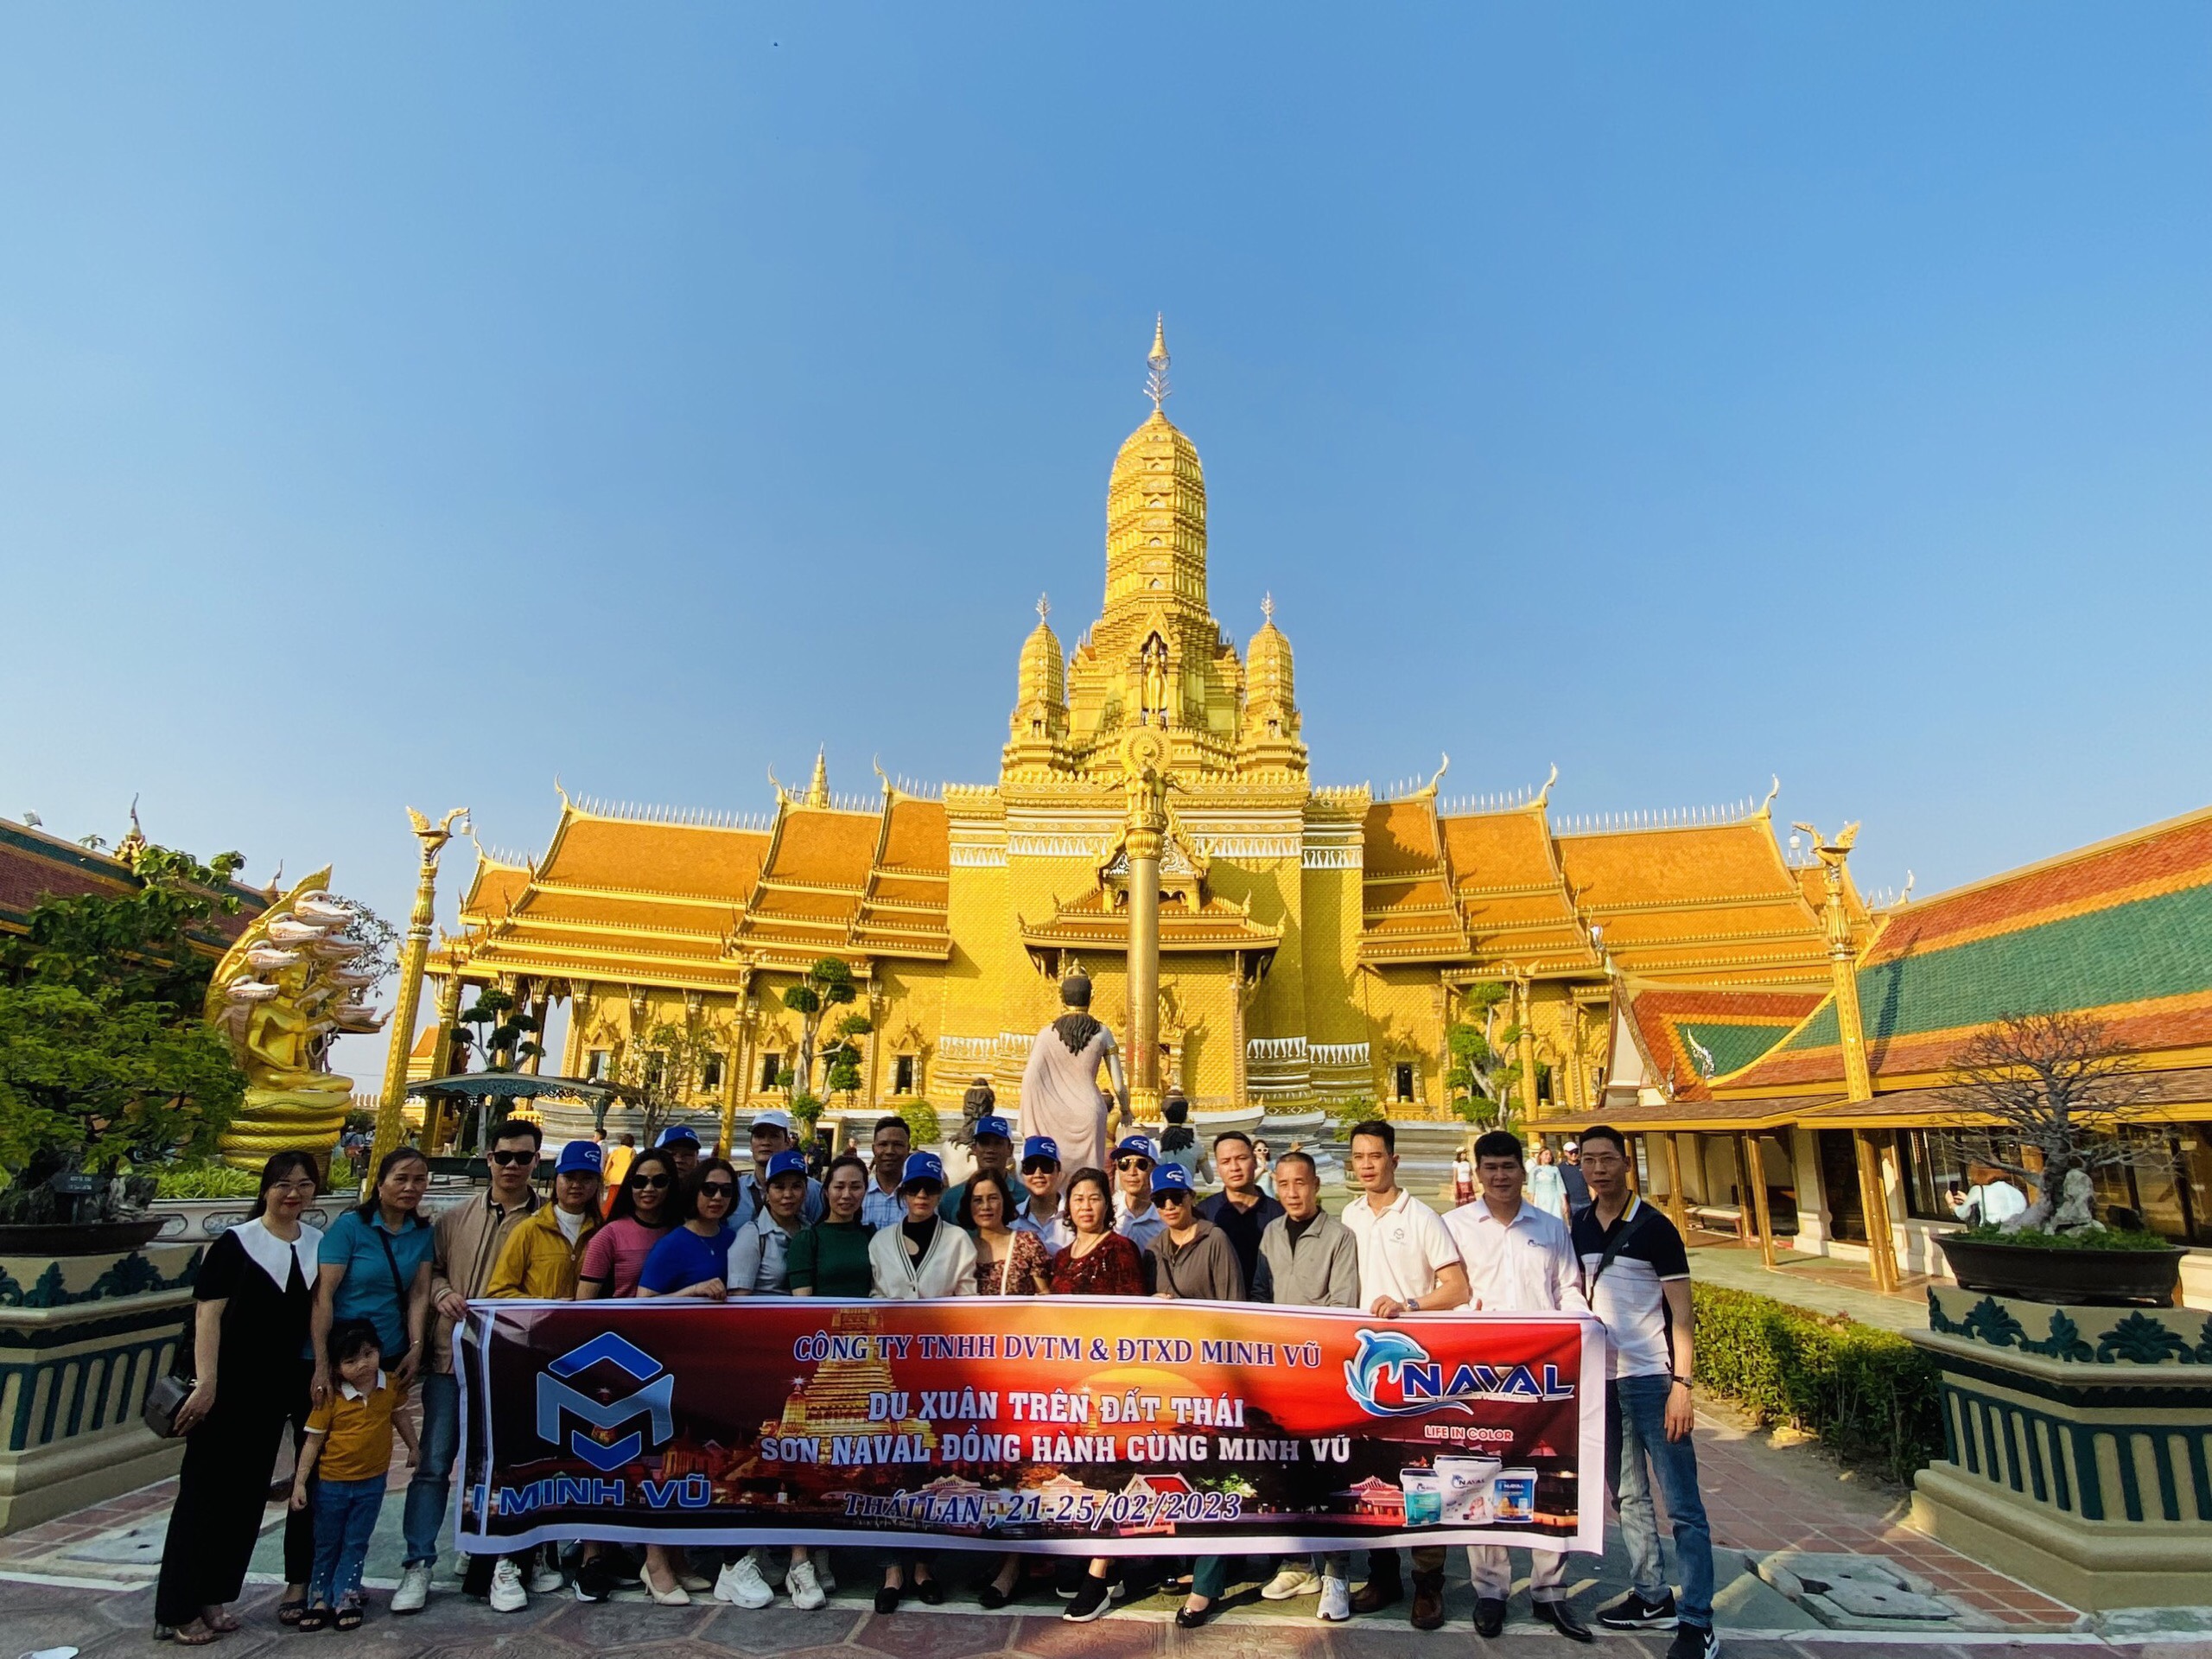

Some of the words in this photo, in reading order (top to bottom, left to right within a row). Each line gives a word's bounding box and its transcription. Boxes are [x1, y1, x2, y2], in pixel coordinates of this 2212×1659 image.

[794, 1331, 868, 1361] CÔNG
[876, 1335, 913, 1359] TY
[918, 1335, 995, 1359] TNHH
[1003, 1335, 1081, 1361] DVTM
[1089, 1338, 1109, 1361] &
[1116, 1338, 1192, 1363] ĐTXD
[1200, 1340, 1275, 1365] MINH
[1281, 1341, 1322, 1368] VŨ
[1402, 1363, 1574, 1398] NAVAL
[868, 1391, 909, 1421] DU
[918, 1386, 998, 1420] XUÂN
[1008, 1388, 1090, 1423] TRÊN
[1100, 1387, 1160, 1423] ĐẤT
[1170, 1392, 1244, 1427] THÁI
[760, 1436, 820, 1464] SƠN
[831, 1433, 931, 1465] NAVAL
[941, 1424, 1020, 1462] ĐỒNG
[1032, 1430, 1116, 1463] HÀNH
[1127, 1429, 1208, 1462] CÙNG
[1218, 1437, 1300, 1461] MINH
[1310, 1435, 1351, 1462] VŨ
[1424, 1425, 1448, 1439] LIFE
[1451, 1426, 1465, 1440] IN
[1467, 1427, 1514, 1441] COLOR
[499, 1478, 625, 1516] MINH
[641, 1473, 711, 1508] VŨ
[844, 1490, 918, 1518] THÁI
[1004, 1491, 1242, 1529] 21-25/02/2023
